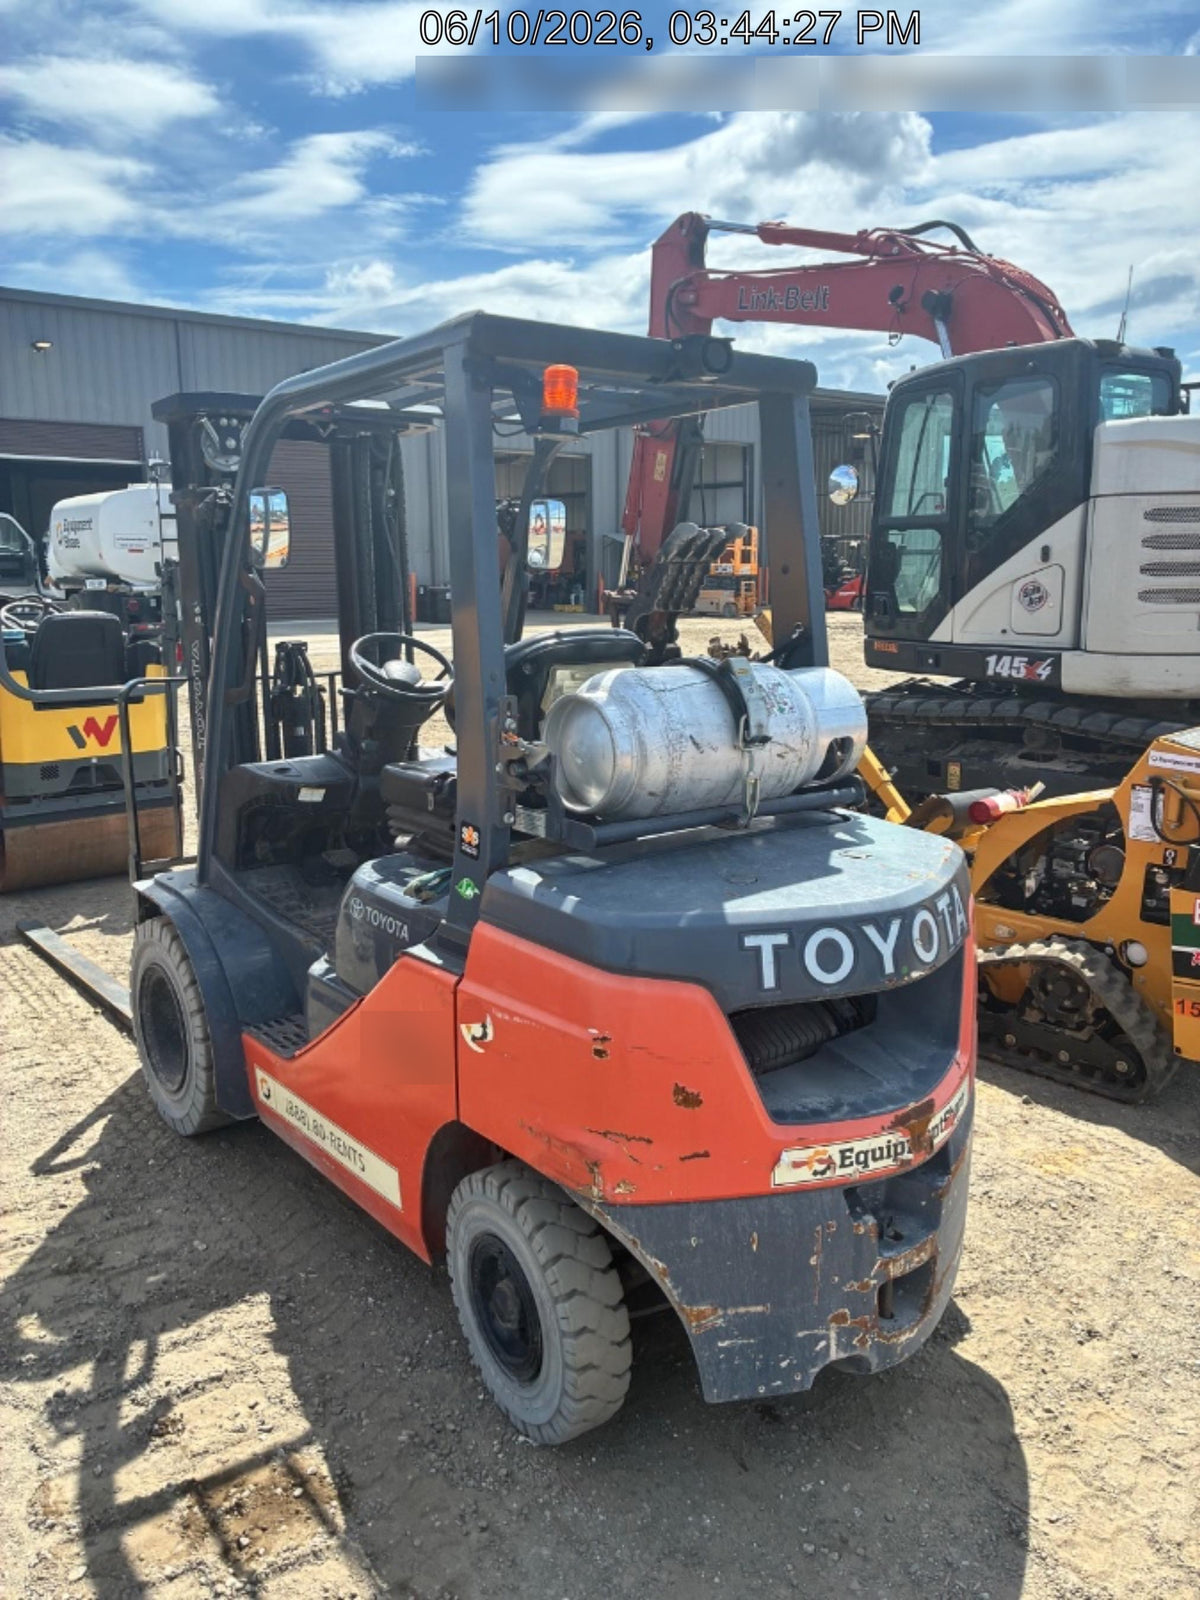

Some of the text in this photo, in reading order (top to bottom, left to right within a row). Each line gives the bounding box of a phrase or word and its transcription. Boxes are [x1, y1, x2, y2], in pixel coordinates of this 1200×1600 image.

[738, 284, 830, 312] Link-Belt
[366, 906, 409, 942] TOYOTA
[744, 884, 968, 989] TOYOTA
